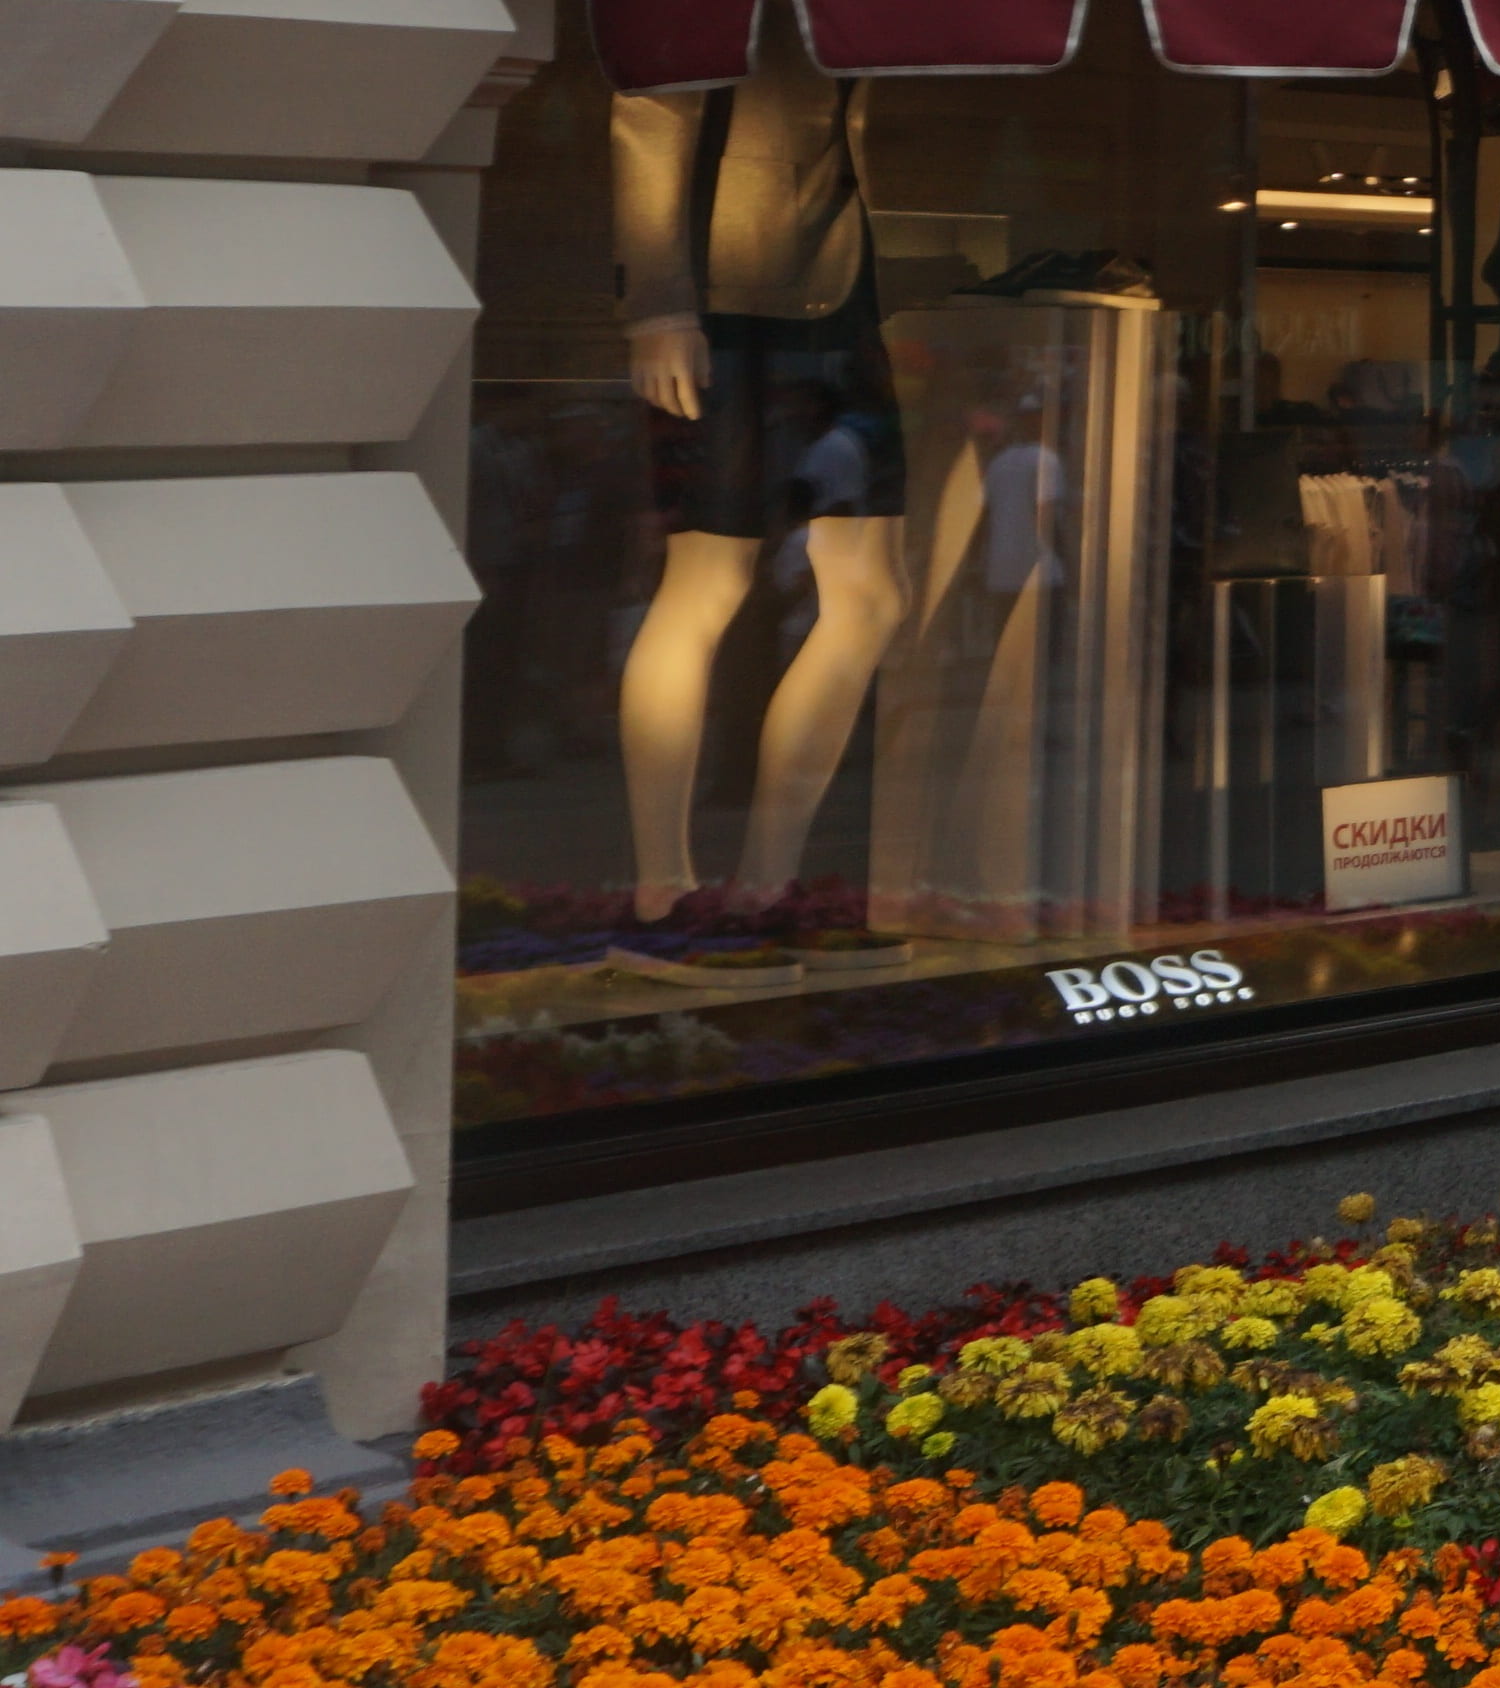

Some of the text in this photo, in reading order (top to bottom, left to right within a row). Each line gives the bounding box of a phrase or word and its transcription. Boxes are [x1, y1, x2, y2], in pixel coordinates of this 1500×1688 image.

[1332, 813, 1446, 850] СКИДКИ
[1333, 845, 1447, 871] ПРОДОЛЖАЮТСЯ
[1045, 949, 1243, 1011] BOSS
